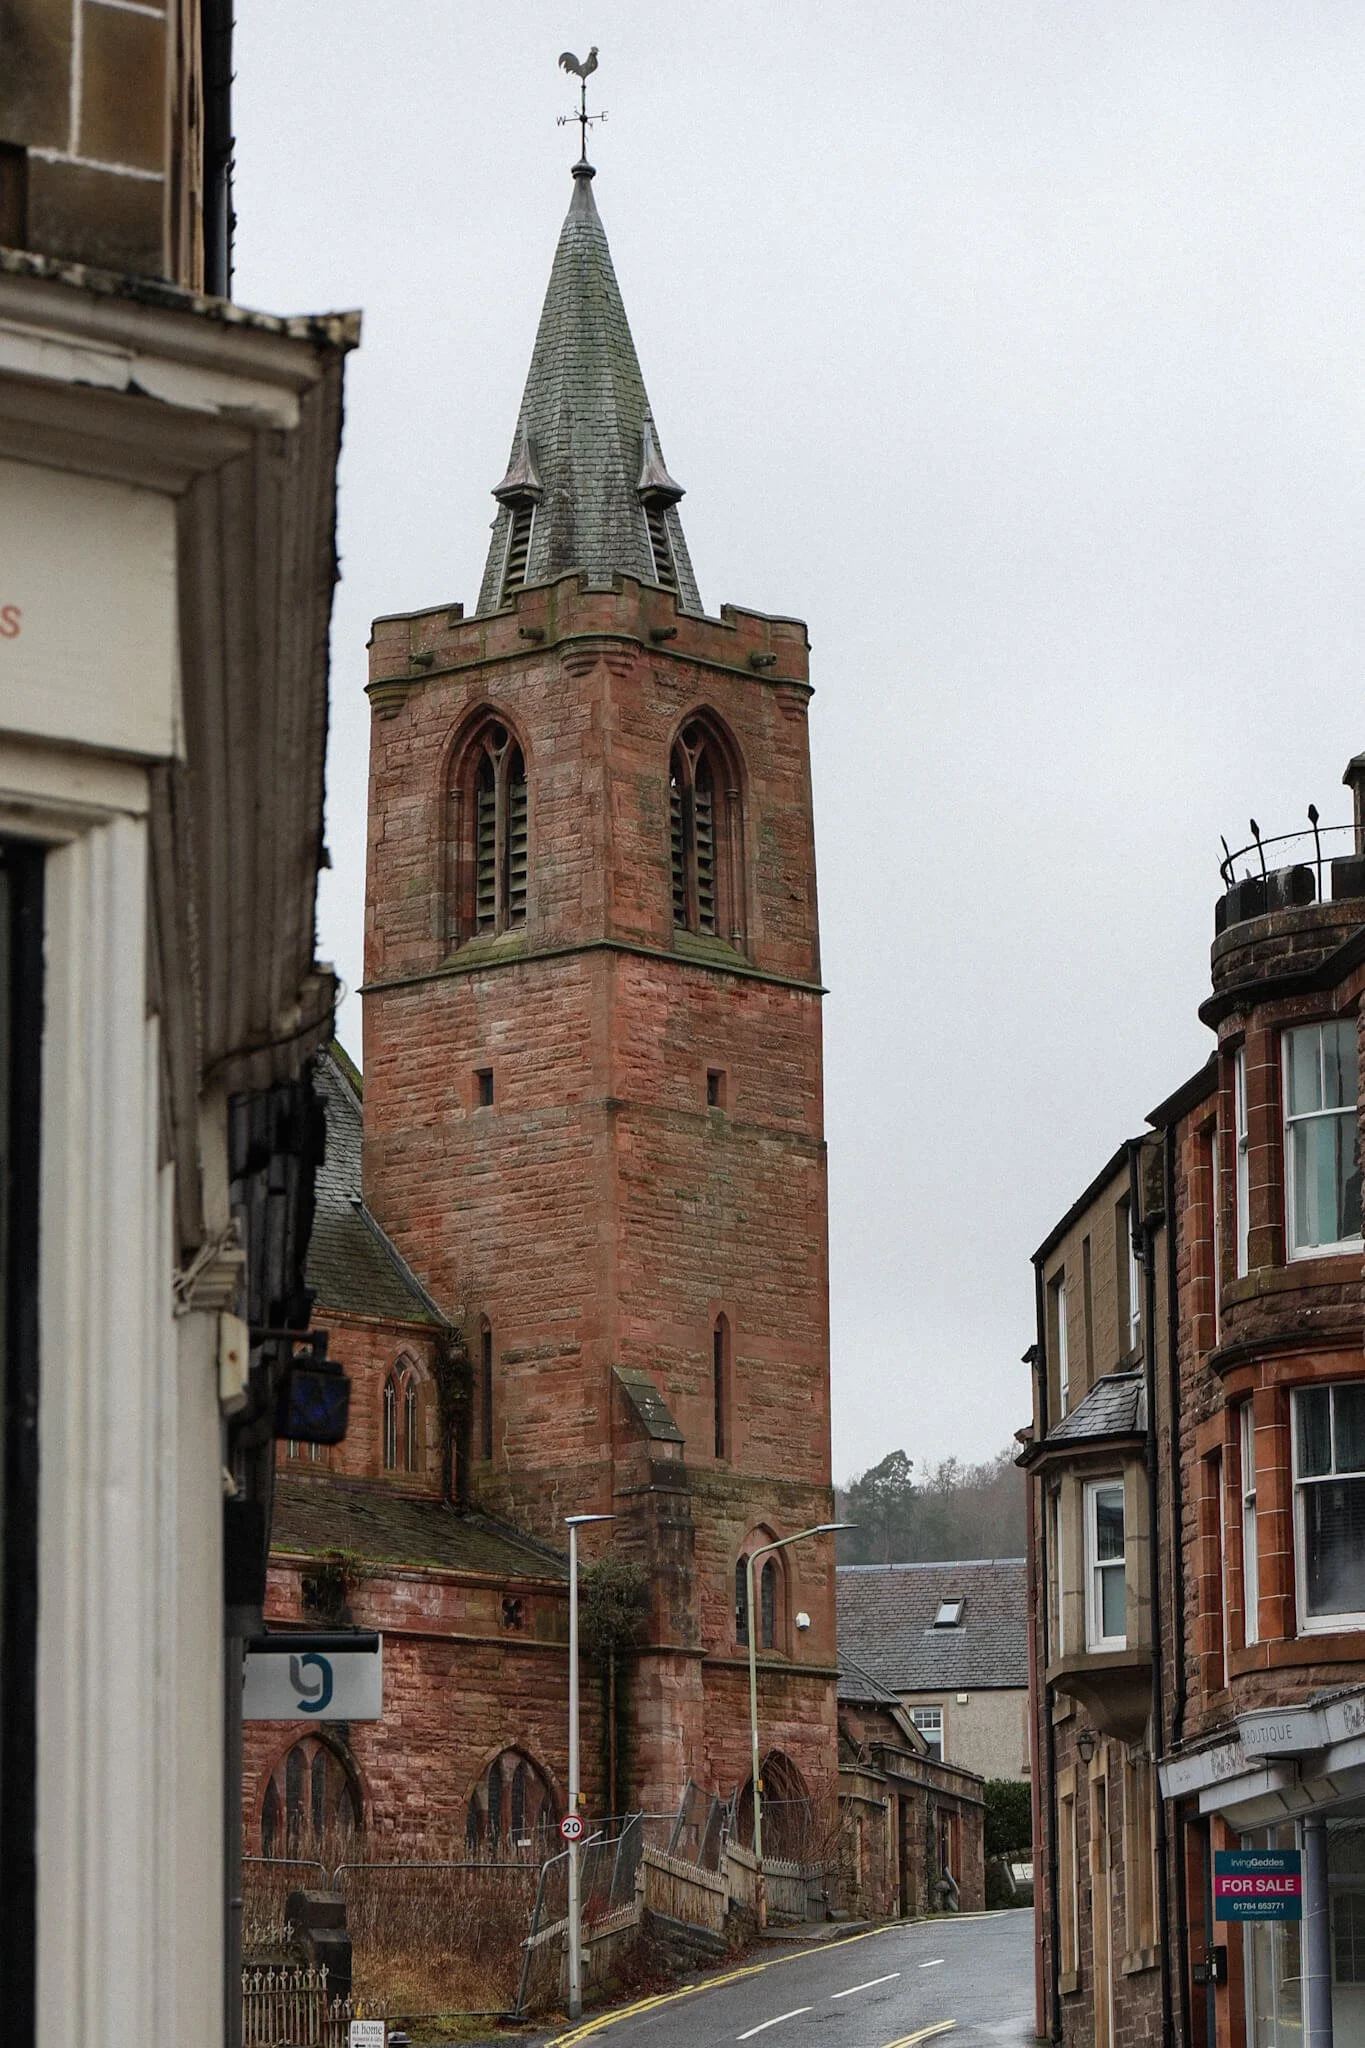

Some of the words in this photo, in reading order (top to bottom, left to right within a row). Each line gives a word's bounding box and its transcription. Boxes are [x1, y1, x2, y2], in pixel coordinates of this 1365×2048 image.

[563, 1822, 580, 1833] 20
[1222, 1879, 1253, 1893] FOR
[1255, 1879, 1295, 1892] SALE
[1233, 1902, 1257, 1911] 01764
[1257, 1902, 1285, 1911] 653771
[361, 2022, 383, 2035] home
